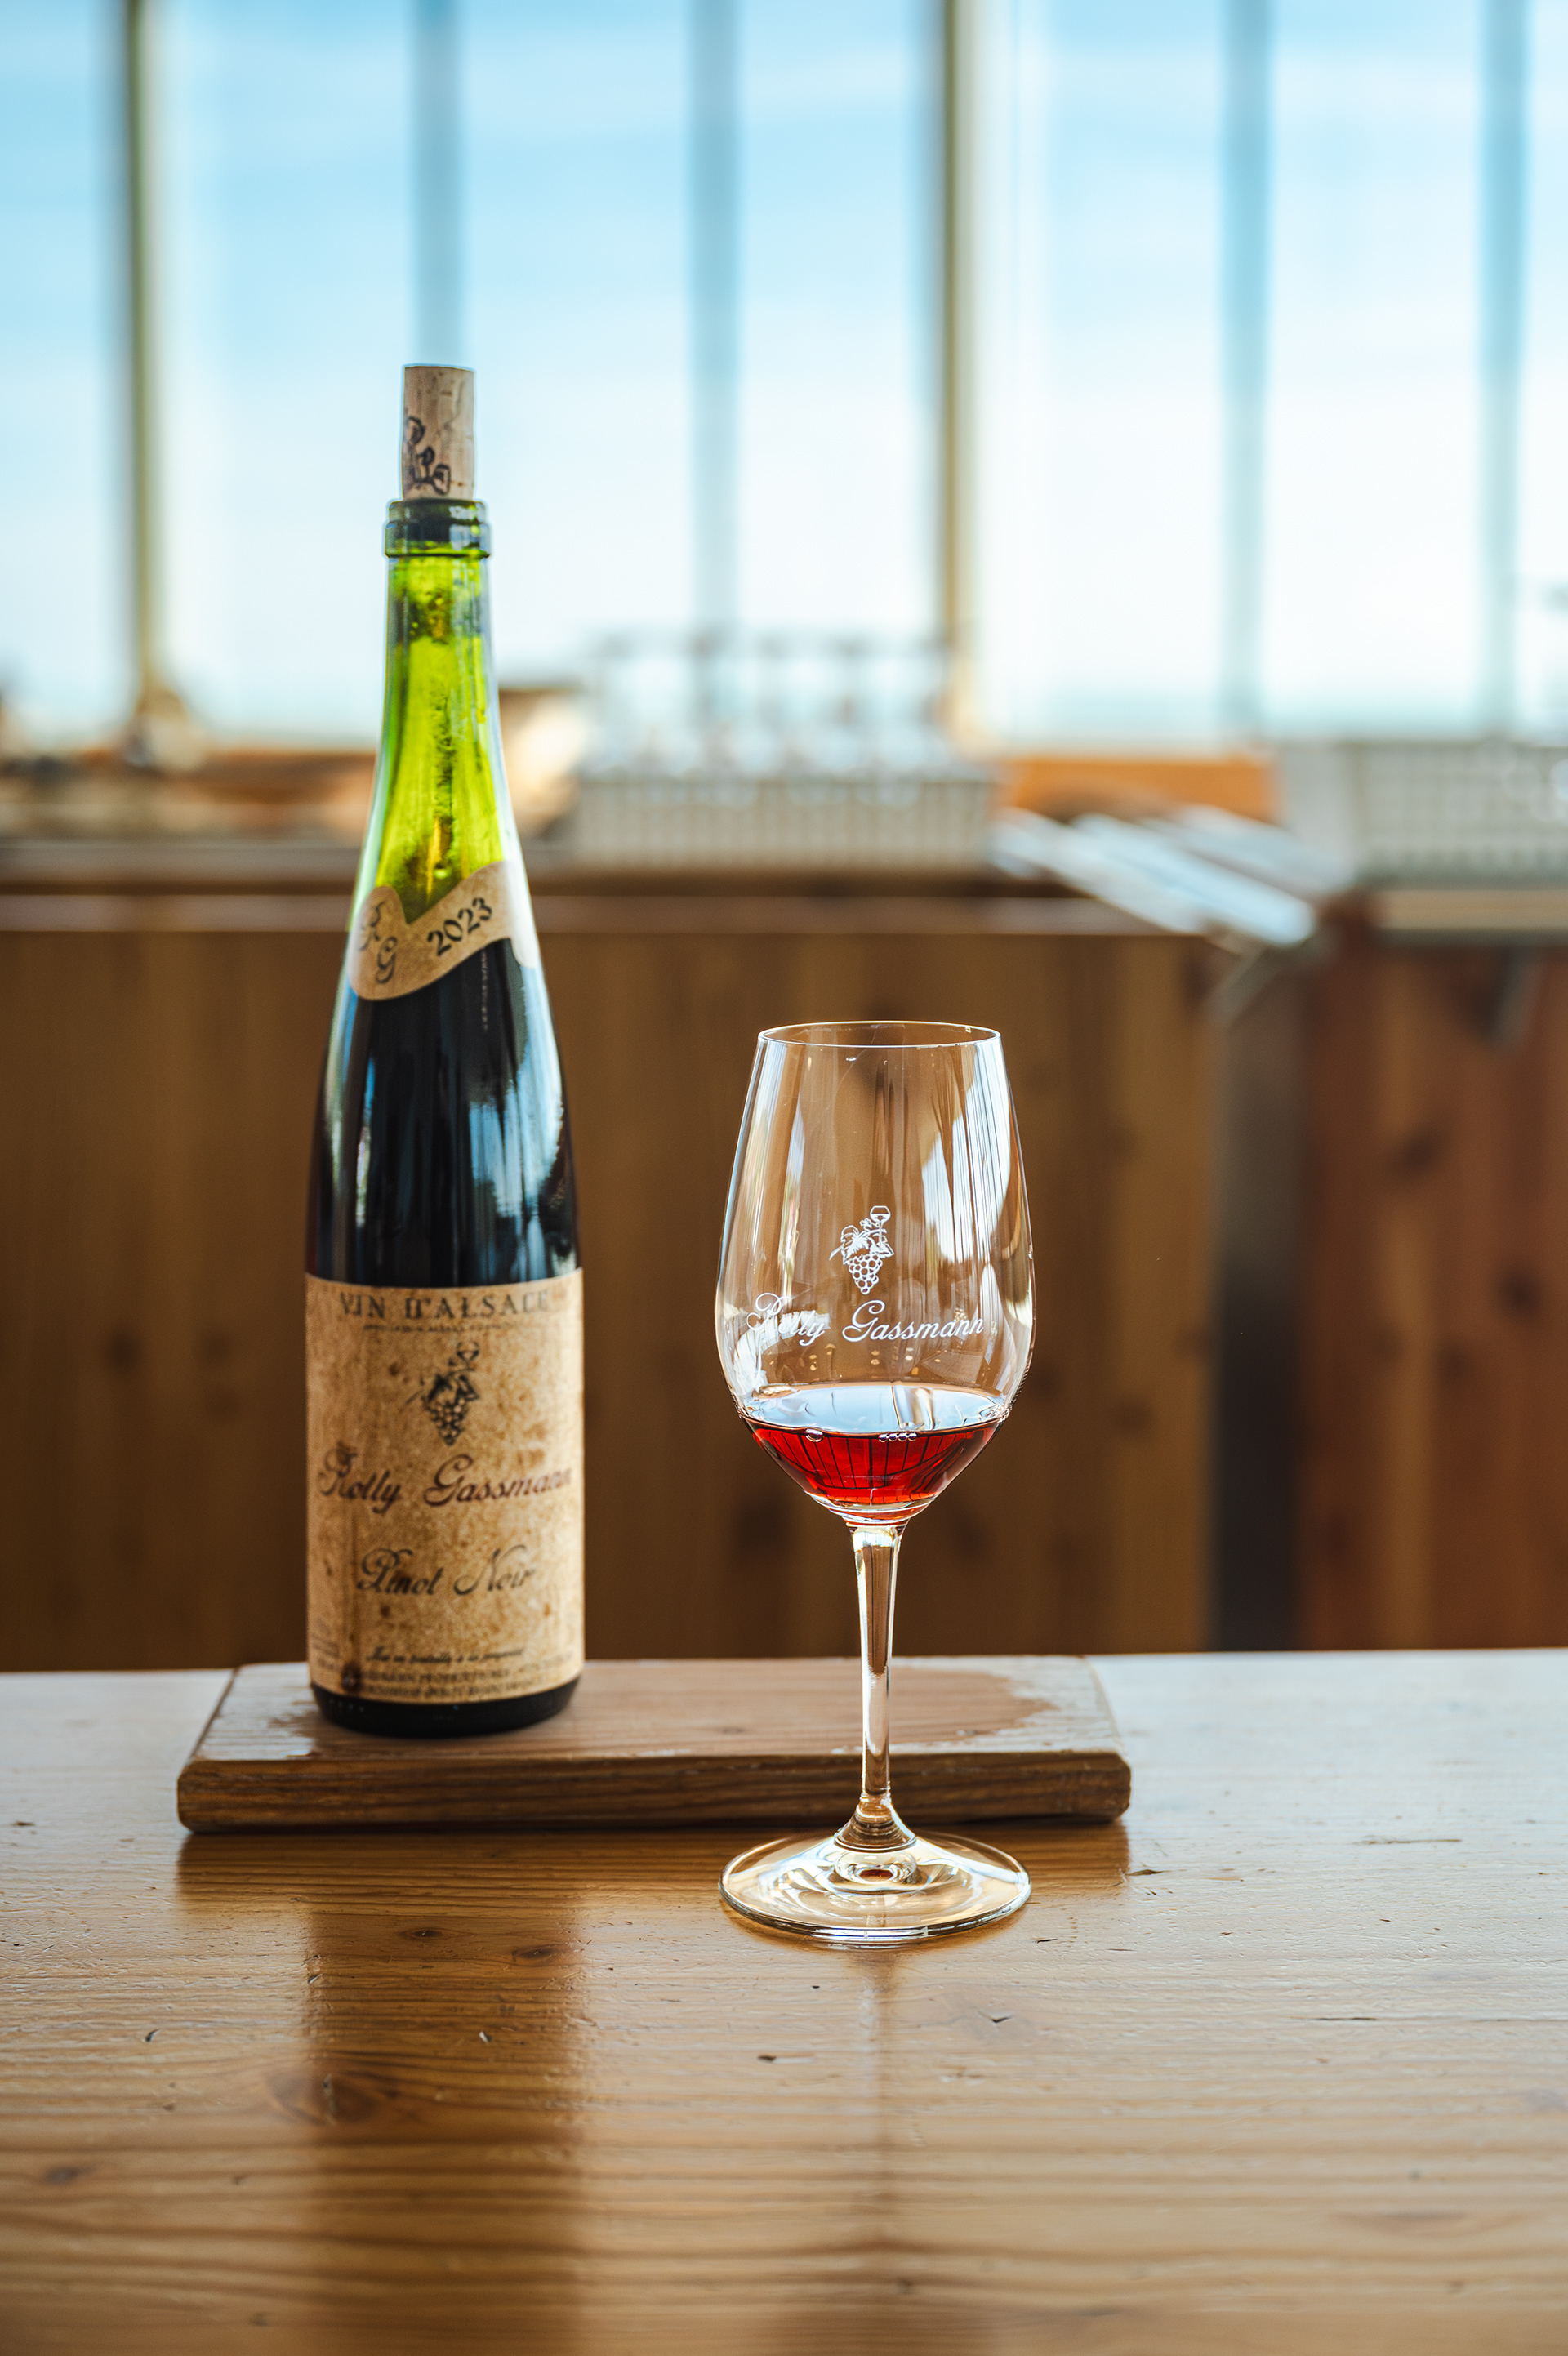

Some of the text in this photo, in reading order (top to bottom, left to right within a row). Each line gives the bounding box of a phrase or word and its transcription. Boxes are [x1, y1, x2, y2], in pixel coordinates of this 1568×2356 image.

[426, 897, 493, 957] 2023
[339, 1291, 385, 1320] VIN
[842, 1299, 985, 1343] Gassmann
[356, 1543, 536, 1597] Pinot Noir
